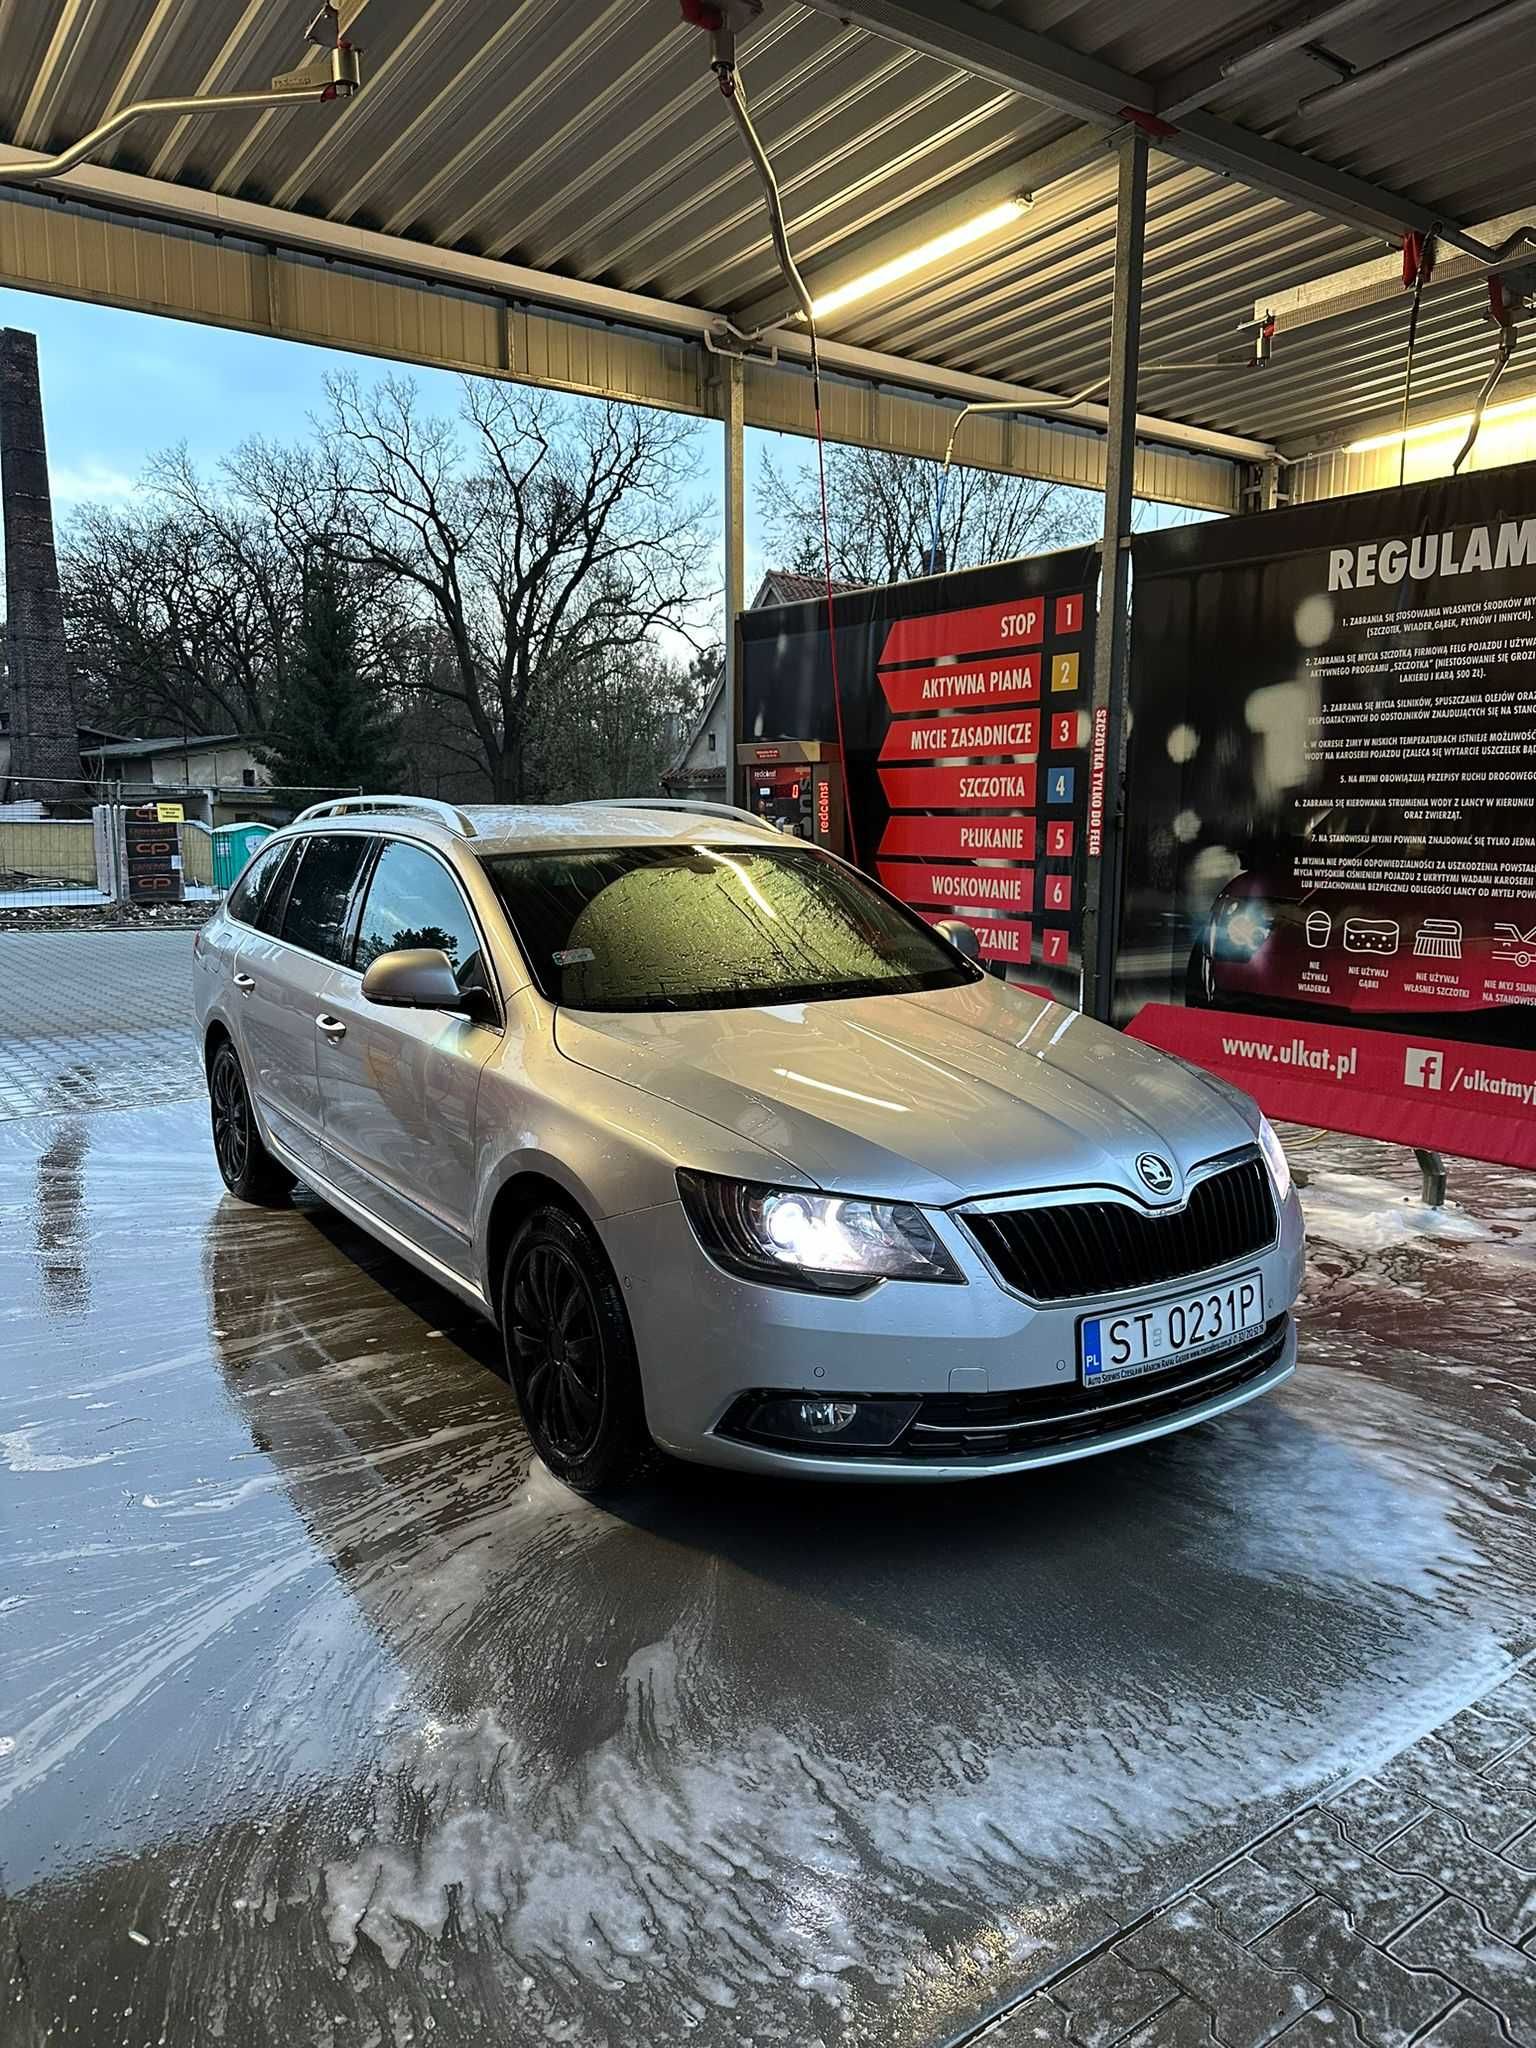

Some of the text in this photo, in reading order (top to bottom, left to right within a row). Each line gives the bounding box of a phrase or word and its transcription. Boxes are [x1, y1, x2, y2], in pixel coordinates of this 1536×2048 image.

[1328, 519, 1536, 591] REGULAM
[1066, 604, 1072, 625] 1
[1343, 597, 1522, 627] 1. ZABRANIA SIĘ STOSOWANIA WŁASNYCH ŚRODKÓW
[1461, 614, 1492, 626] PŁYNÓW
[1499, 610, 1533, 623] INNYCH).
[1001, 612, 1036, 637] STOP
[1305, 658, 1312, 666] 2.
[1314, 656, 1345, 666] ZABRANIA
[1347, 655, 1356, 664] SIĘ
[1358, 653, 1378, 662] MYCIA
[1380, 649, 1412, 660] SZCZOTKĄ
[1415, 646, 1448, 657] FIRMOWĄ
[1450, 644, 1466, 654] FELG
[1469, 640, 1502, 652] POJAZDU
[1061, 662, 1069, 684] 2
[1311, 667, 1350, 678] AKTYWNEGO
[1352, 664, 1389, 675] PROGRAMU
[1435, 654, 1495, 669] (NIESTOSOWANIE
[1498, 653, 1508, 663] SIĘ
[1511, 651, 1536, 661] GROZI
[922, 668, 1032, 699] AKTYWNA PIANA
[1400, 673, 1429, 683] LAKIERU
[1435, 671, 1454, 681] KARĄ
[1457, 670, 1470, 679] 500
[1323, 705, 1329, 713] 3.
[1331, 703, 1363, 712] ZABRANIA
[1365, 702, 1374, 711] SIĘ
[1375, 701, 1395, 710] MYCIA
[1397, 696, 1433, 708] SILNIKÓW,
[1435, 694, 1482, 706] SPUSZCZANIA
[1485, 691, 1515, 703] OLEJÓW
[1370, 714, 1378, 722] DO
[1381, 709, 1431, 721] ODSTOJNIKÓW
[1432, 708, 1486, 719] ZNAJDUJĄCYCH
[1488, 707, 1499, 717] SIĘ
[1501, 706, 1511, 715] NA
[911, 723, 1032, 750] MYCIE ZASADNICZE
[1060, 720, 1069, 742] 3
[1319, 740, 1344, 748] OKRESIE
[1346, 739, 1362, 747] ZIMY
[1364, 739, 1370, 747] W
[1372, 737, 1397, 746] NISKICH
[1400, 735, 1457, 745] TEMPERATURACH
[1459, 734, 1488, 742] ISTNIEJE
[1305, 746, 1520, 760] WODY NA KAROSERII POJAZDU (ZALECA SIĘ WYTARCIE USZCZELEK
[1056, 776, 1065, 796] 4
[1089, 709, 1107, 855] SZCZOTKA TYLKO DO FELG
[1349, 775, 1357, 783] NA
[1359, 775, 1378, 783] MYJNI
[1380, 774, 1425, 784] OBOWIĄZUJĄ
[1427, 773, 1460, 782] PRZEPISY
[1462, 773, 1487, 781] RUCHU
[792, 785, 799, 799] 0
[960, 777, 1025, 798] SZCZOTKA
[1303, 800, 1333, 808] ZABRANIA
[1336, 799, 1345, 808] SIĘ
[1346, 799, 1386, 807] KIEROWANIA
[1389, 799, 1428, 807] STRUMIENIA
[1431, 798, 1452, 807] WODY
[1454, 799, 1459, 807] Z
[1461, 798, 1485, 807] LANCY
[1486, 798, 1494, 807] W
[1496, 798, 1534, 807] KIERUNKU
[1404, 811, 1462, 821] ORAZ ZWIERZĄT.
[961, 828, 1023, 849] PŁUKANIE
[1056, 829, 1064, 850] 5
[1329, 835, 1370, 844] STANOWISKU
[1371, 835, 1392, 844] MYJNI
[1394, 836, 1426, 845] POWINNA
[1428, 834, 1473, 845] ZNAJDOWAĆ
[1475, 837, 1485, 847] SIĘ
[1487, 837, 1510, 846] TYLKO
[1512, 838, 1536, 847] JEDNA
[1295, 857, 1498, 871] 8. MYJNIA NIE PONOSI ODPOWIEDZIALNOŚCI ZA USZKODZENIA
[1294, 869, 1534, 885] MYCIA WYSOKIM CIŚNIENIEM POJAZDU Z UKRYTYMI WADAMI KAROSERII
[932, 876, 1021, 900] WOSKOWANIE
[1054, 883, 1063, 904] 6
[1301, 880, 1514, 898] LUB NIEZACHOWANIA BEZPIECZNEJ ODLEGŁOŚCI LANCY OD MYTEJ
[1052, 937, 1060, 957] 7
[1309, 962, 1320, 970] NIE
[1348, 966, 1389, 978] NIE UŻYWAJ
[1302, 972, 1328, 982] UŻYWAJ
[1359, 979, 1379, 990] GĄBKI
[1416, 972, 1459, 985] NIE UŻYWAJ
[1484, 980, 1496, 989] NIE
[1498, 981, 1514, 991] MYJ
[1298, 983, 1331, 994] WIADERKA
[1404, 984, 1470, 998] WŁASNEJ SZCZOTKI
[1483, 993, 1493, 1002] NA
[1222, 1037, 1357, 1079] www.ulkat.pl
[1109, 1313, 1153, 1364] ST
[1169, 1284, 1255, 1349] 0231P
[1086, 1354, 1100, 1368] PL
